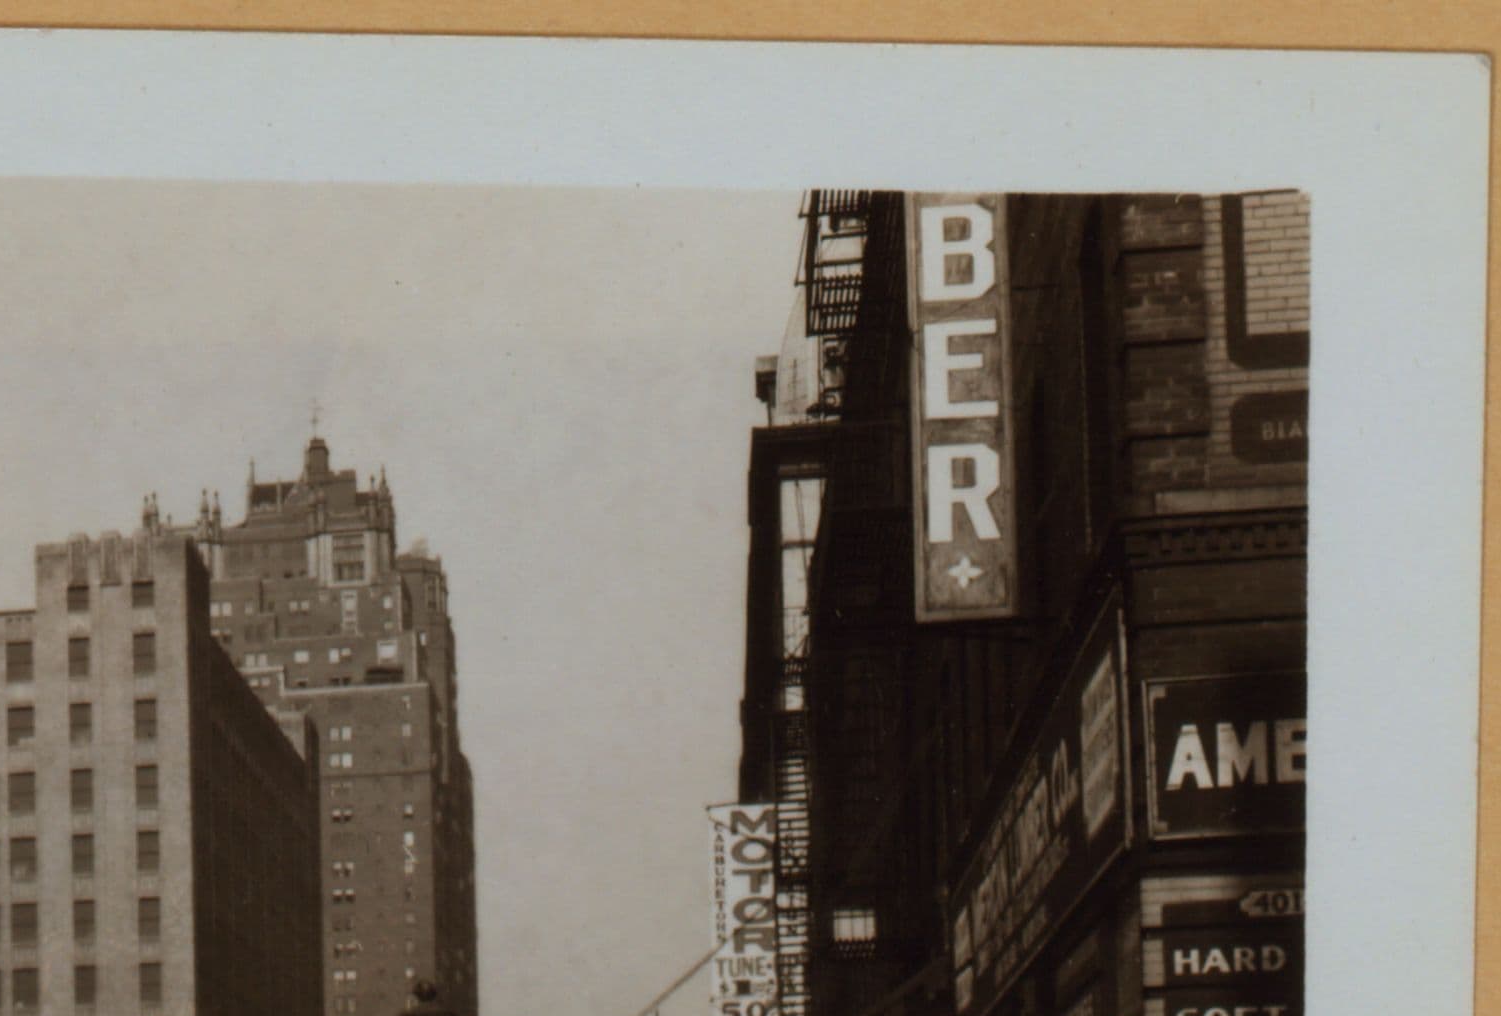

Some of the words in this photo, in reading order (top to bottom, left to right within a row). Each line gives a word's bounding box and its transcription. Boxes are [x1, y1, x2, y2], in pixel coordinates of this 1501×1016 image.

[920, 203, 1001, 544] BER
[1165, 718, 1306, 790] AME
[730, 808, 778, 954] MOTOR
[1173, 945, 1286, 976] HARD
